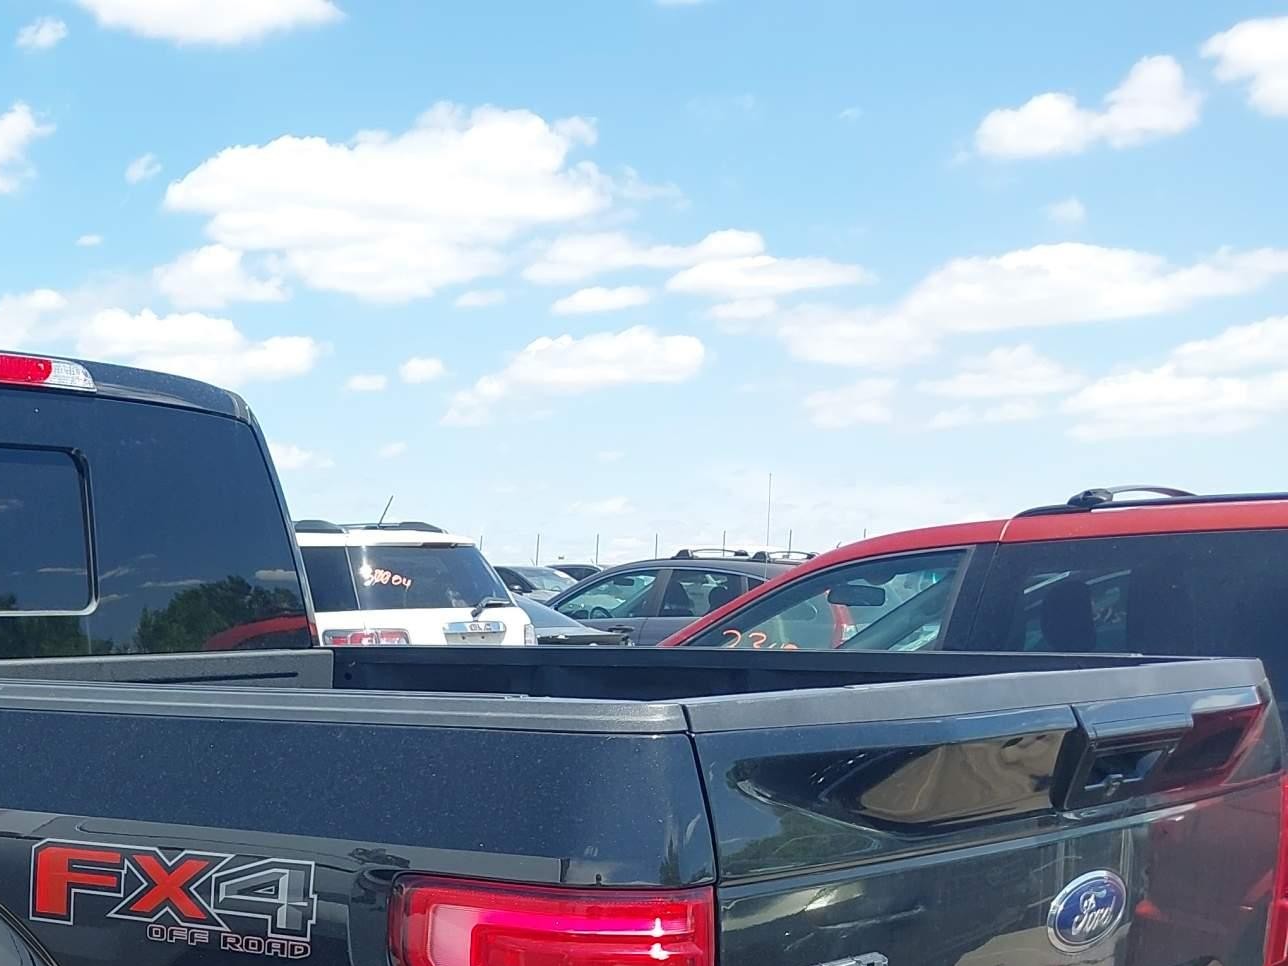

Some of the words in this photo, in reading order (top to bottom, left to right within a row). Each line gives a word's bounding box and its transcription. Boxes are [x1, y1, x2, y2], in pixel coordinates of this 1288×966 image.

[29, 838, 318, 941] FX4
[1071, 889, 1116, 936] Ford
[147, 923, 210, 947] OFF
[220, 931, 311, 959] ROAD
